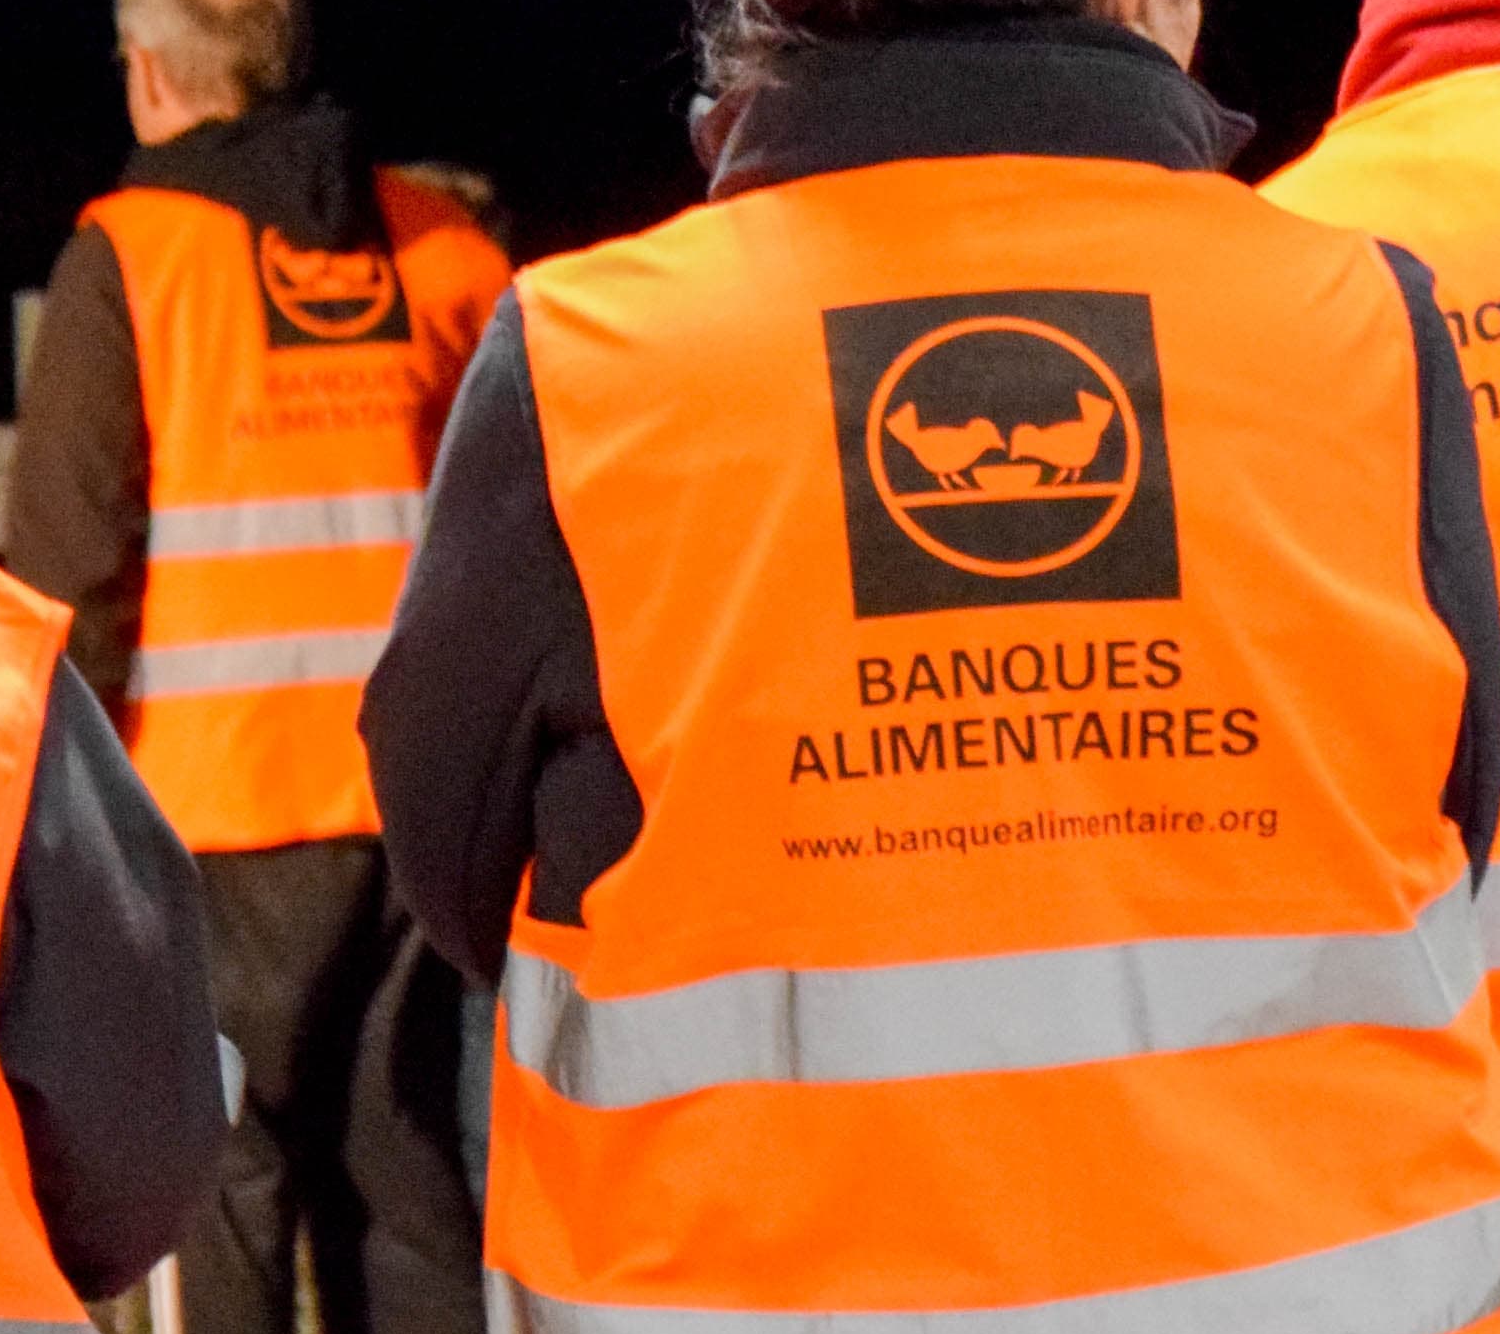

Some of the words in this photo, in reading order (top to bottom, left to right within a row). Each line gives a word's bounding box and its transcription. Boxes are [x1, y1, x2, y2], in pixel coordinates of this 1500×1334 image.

[857, 639, 1183, 707] BANQUES
[788, 706, 1260, 785] ALIMENTAIRES
[782, 805, 1279, 861] www.banquealimentaire.org
